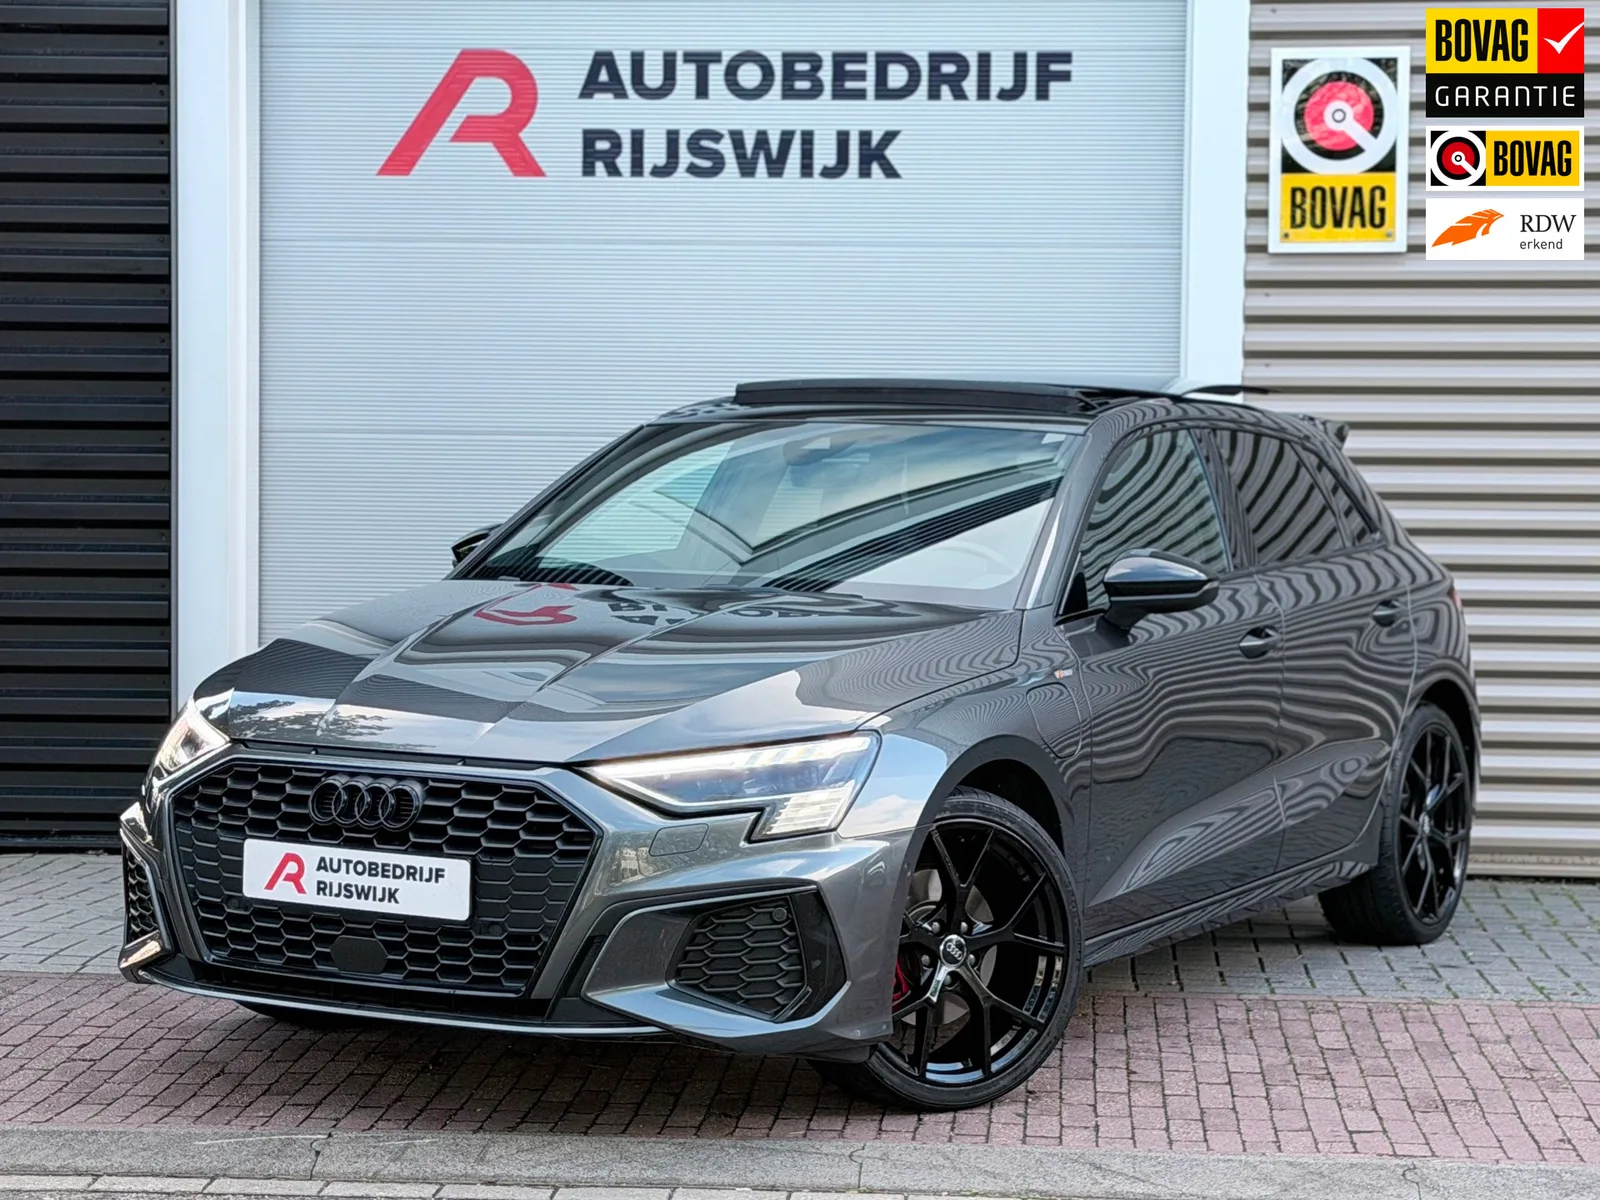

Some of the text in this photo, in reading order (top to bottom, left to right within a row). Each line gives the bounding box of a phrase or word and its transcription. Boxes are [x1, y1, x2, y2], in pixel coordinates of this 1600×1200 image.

[578, 49, 1073, 102] AUTOBEDRIJF
[581, 128, 903, 180] RIJSWIJK
[1290, 185, 1386, 229] BOVAG
[315, 856, 446, 884] AUTOBEDRIJF
[315, 880, 401, 905] RIJSWIJK
